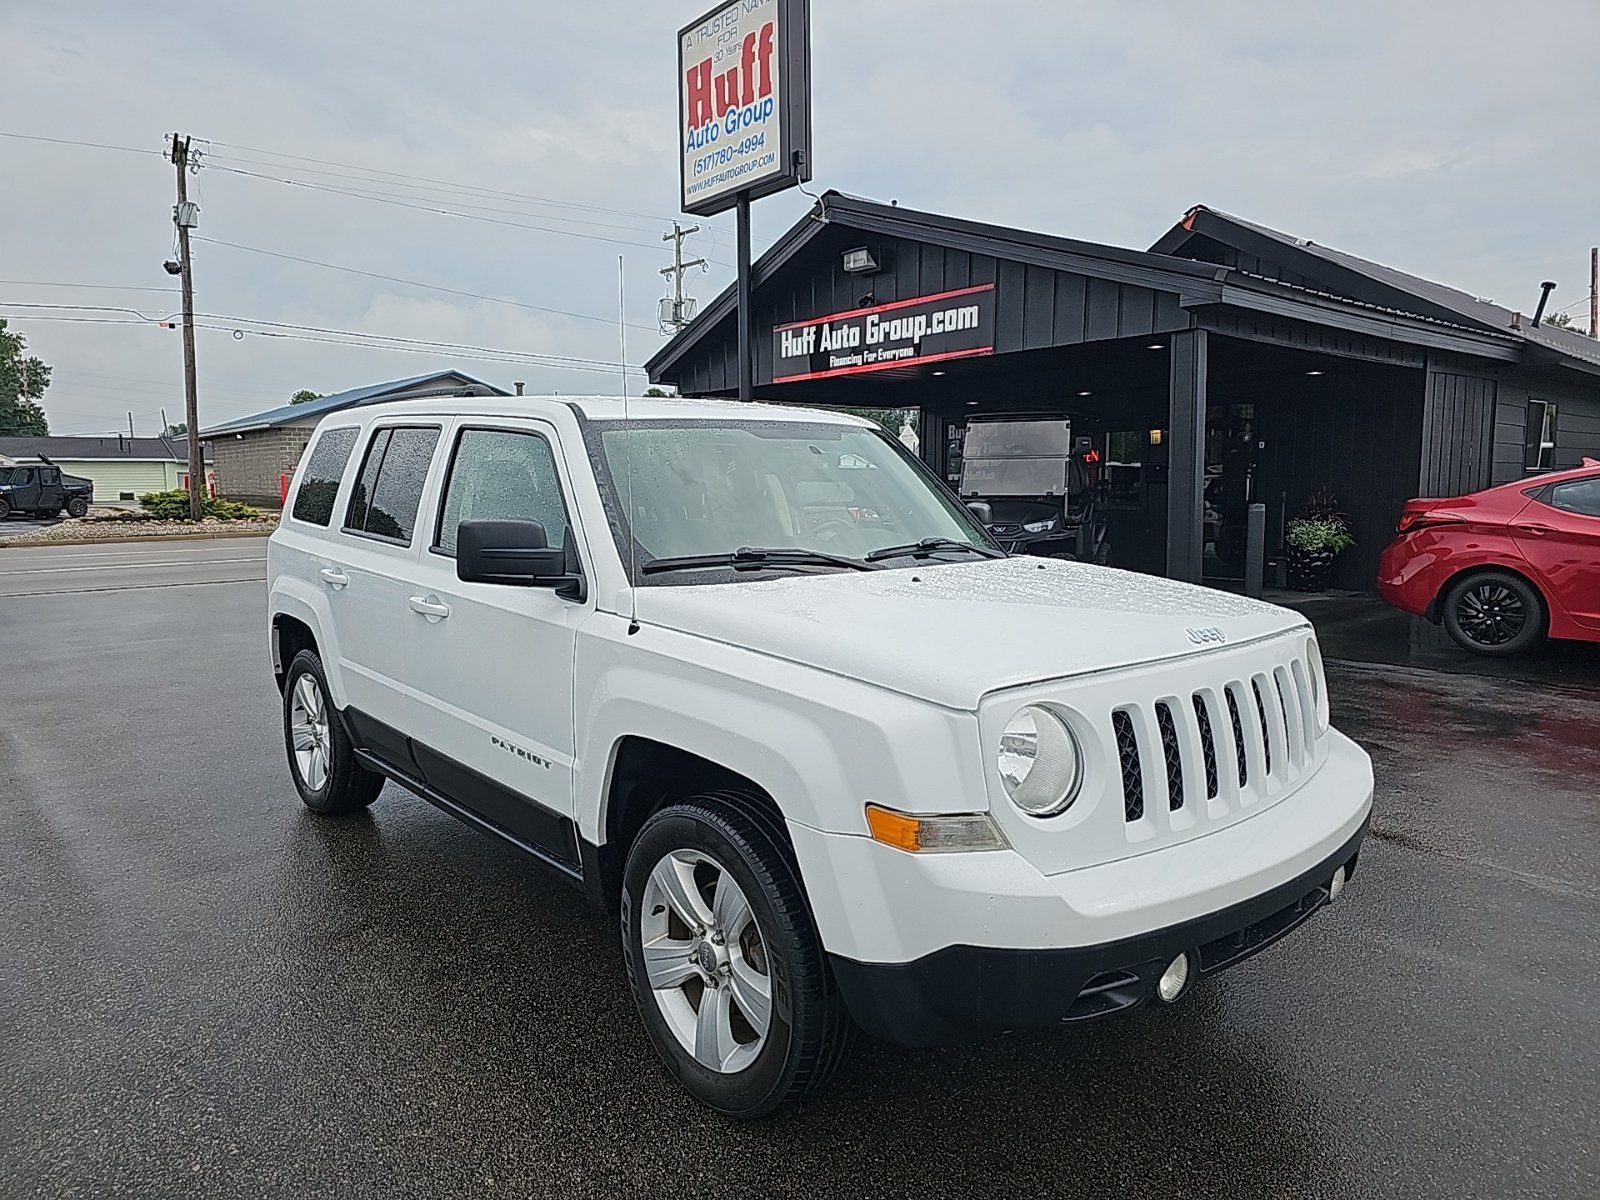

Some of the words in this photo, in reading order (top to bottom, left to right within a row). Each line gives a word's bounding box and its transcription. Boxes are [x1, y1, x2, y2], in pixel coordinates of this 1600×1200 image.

[686, 35, 693, 51] A
[695, 7, 739, 44] TRUSTED
[742, 0, 770, 18] NA
[717, 26, 738, 47] FOR
[686, 21, 774, 131] Huff
[686, 123, 719, 153] Auto
[725, 97, 774, 135] Group
[687, 153, 775, 195] WWW.HUFFAUTOGROUP.COM
[693, 132, 765, 177] (517)780-4994
[781, 326, 817, 358] Huff
[820, 323, 861, 352] Auto
[865, 305, 979, 345] Group.com
[829, 350, 863, 368] Financing
[863, 348, 878, 363] For
[878, 346, 914, 362] Everyone
[1185, 627, 1226, 644] Jeep
[491, 736, 552, 770] PATRIOT
